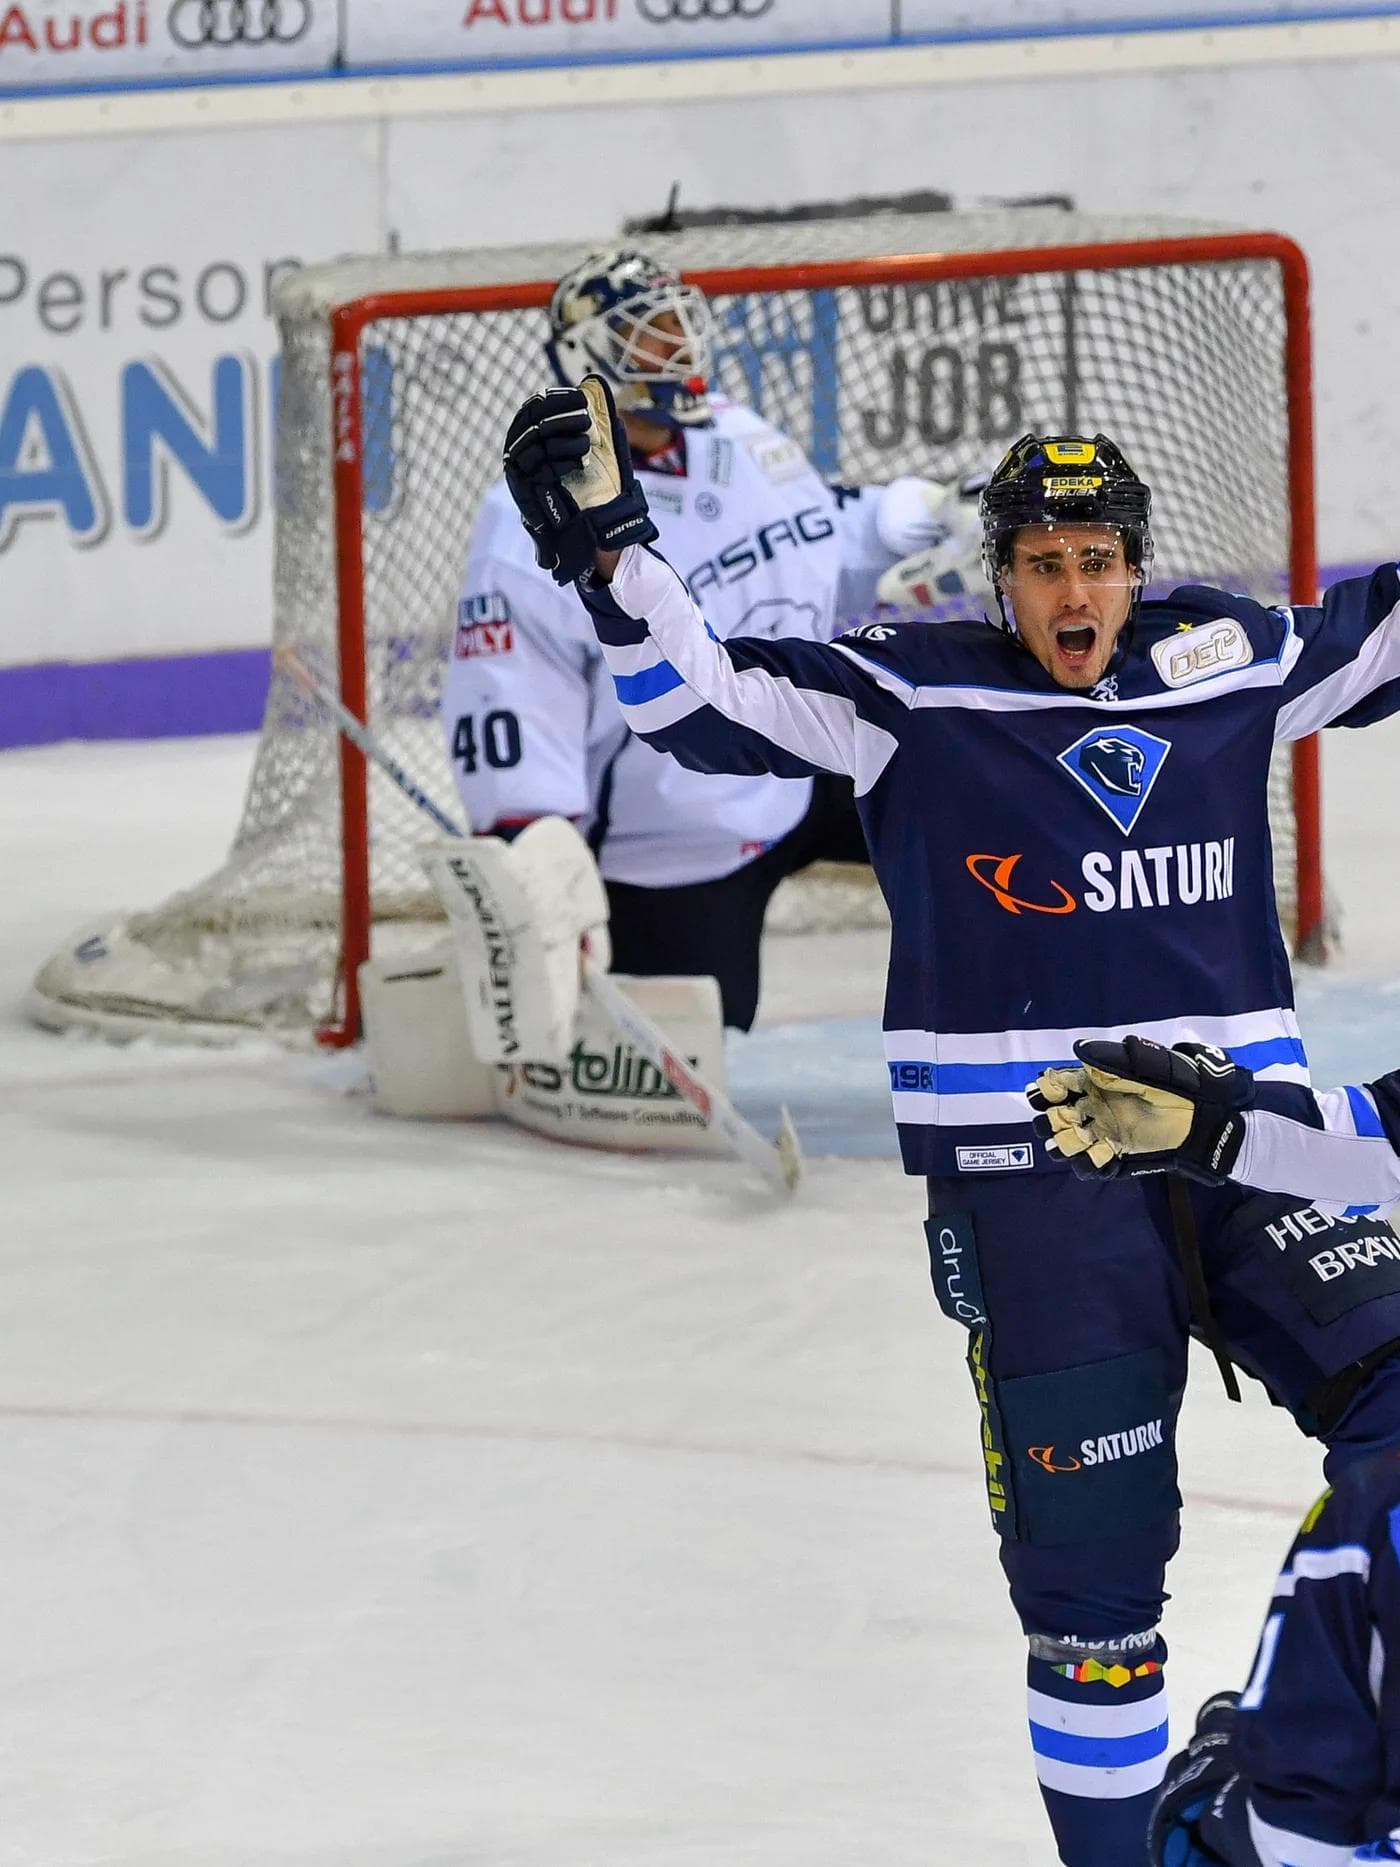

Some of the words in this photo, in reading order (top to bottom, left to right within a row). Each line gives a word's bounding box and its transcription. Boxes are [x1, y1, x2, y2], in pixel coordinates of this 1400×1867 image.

[0, 0, 149, 53] Audi
[1051, 477, 1095, 487] EDEKA
[1169, 628, 1238, 680] DEL
[453, 709, 522, 773] 40
[1081, 837, 1234, 913] SATURN
[1211, 1120, 1234, 1170] BAUER
[1081, 1418, 1163, 1467] SATURN
